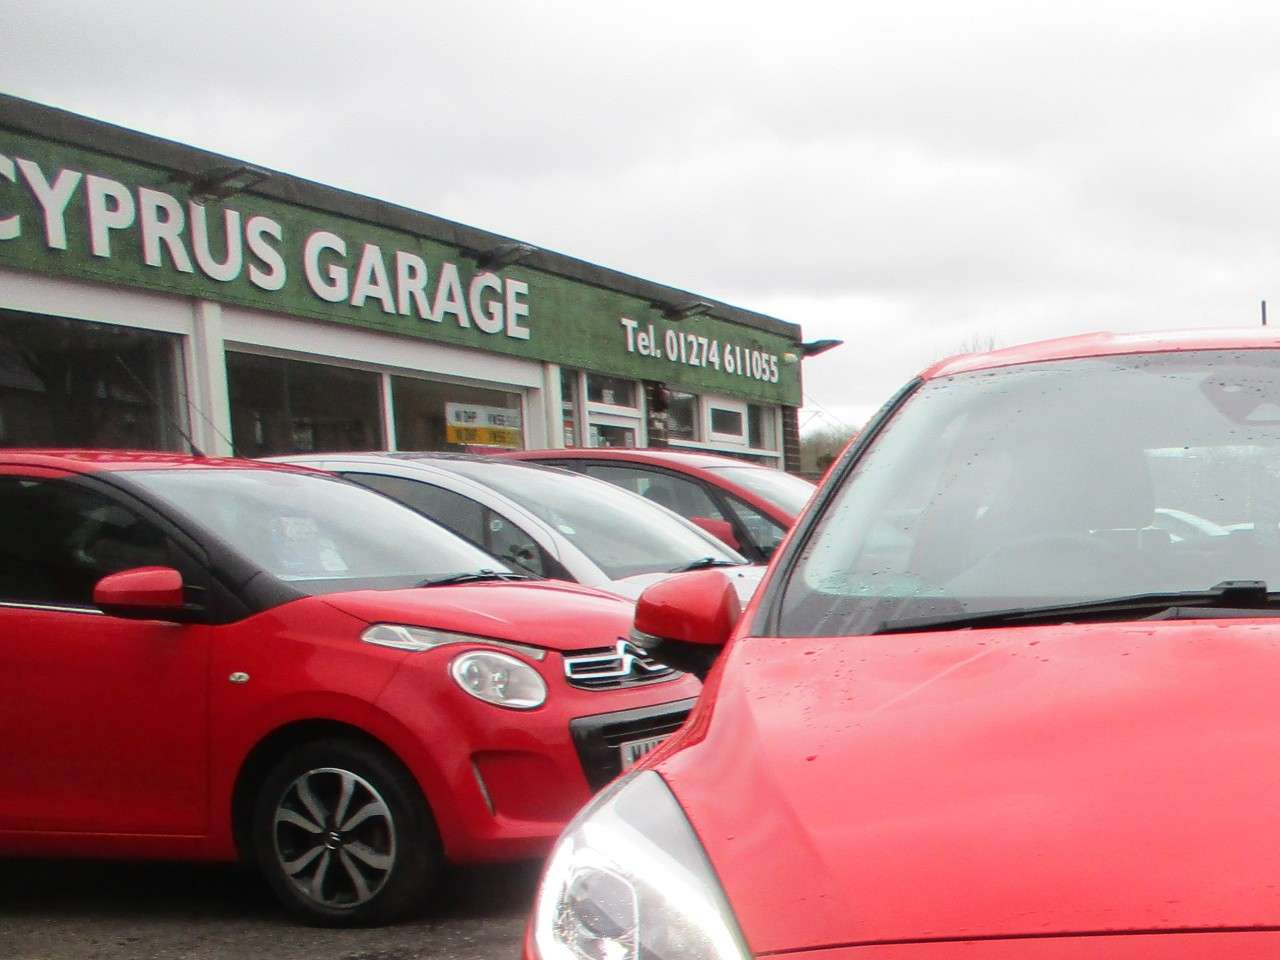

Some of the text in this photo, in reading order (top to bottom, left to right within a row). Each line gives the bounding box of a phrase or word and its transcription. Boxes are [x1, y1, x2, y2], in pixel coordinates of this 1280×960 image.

[304, 231, 530, 340] GARAGE
[621, 318, 779, 384] Tel. 01274 611055
